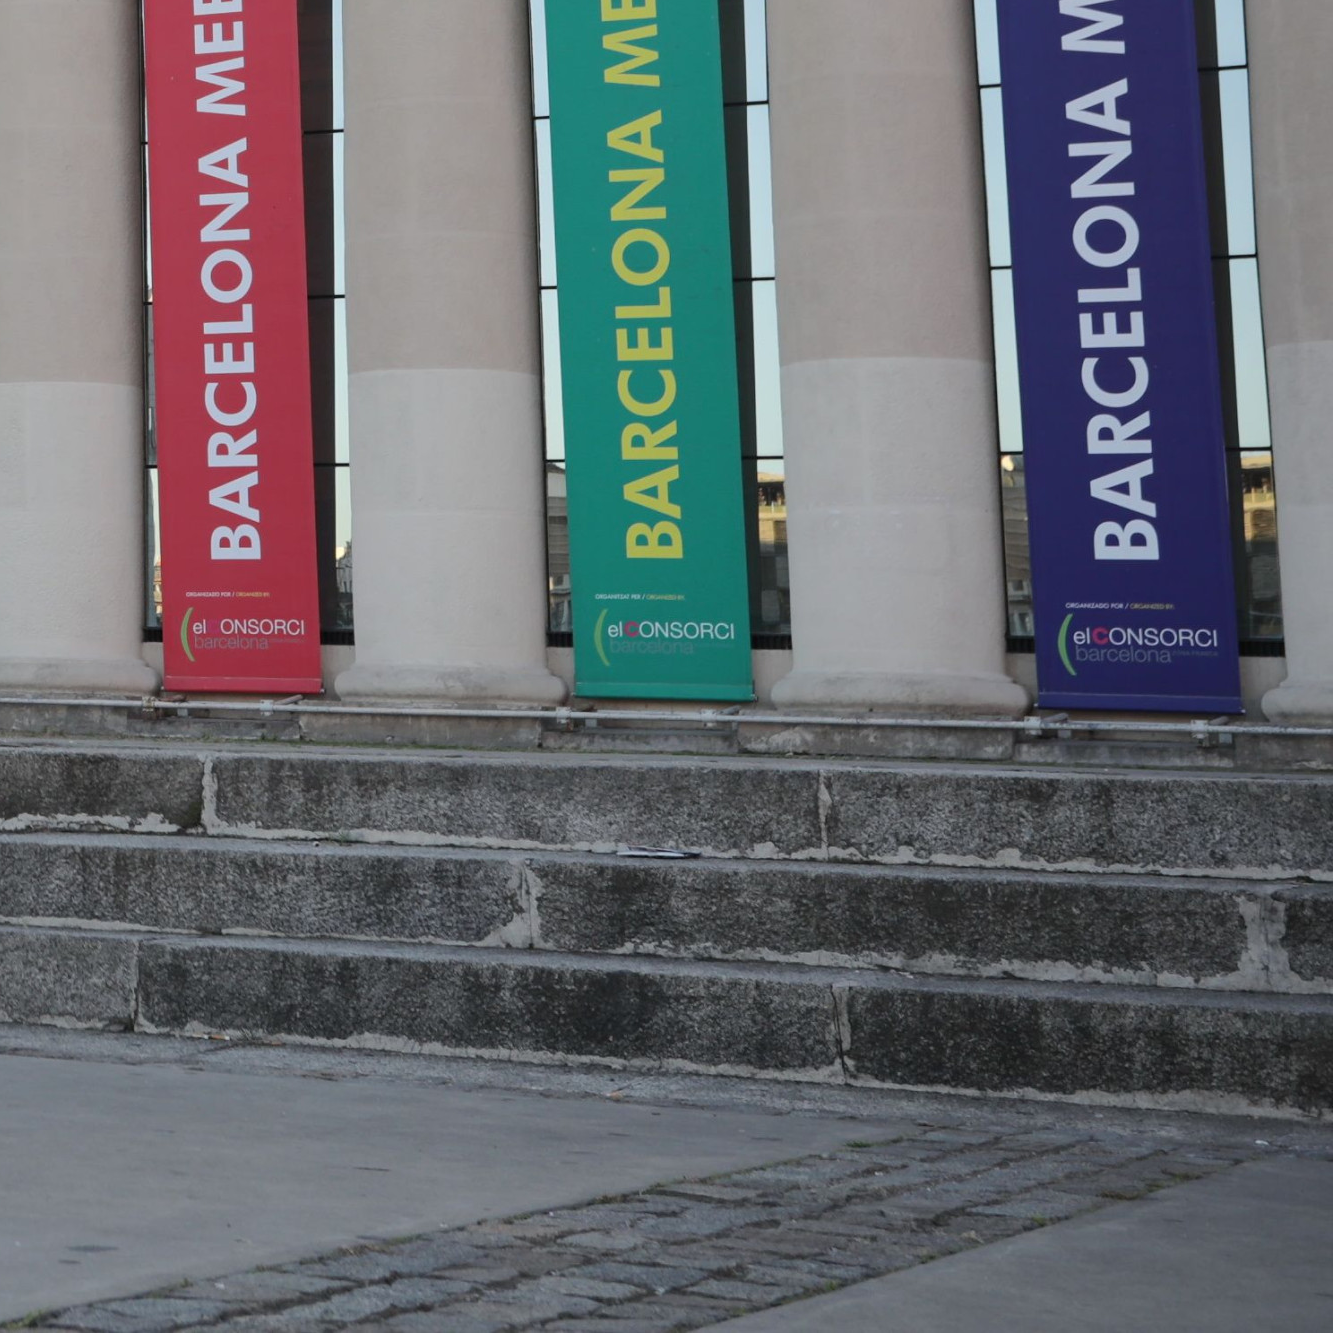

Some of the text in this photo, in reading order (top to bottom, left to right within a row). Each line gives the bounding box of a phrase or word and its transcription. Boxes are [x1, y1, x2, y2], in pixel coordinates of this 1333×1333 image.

[197, 137, 262, 561] BARCELONA
[607, 111, 683, 558] BARCELONA
[1065, 77, 1160, 561] BARCELONA
[1075, 645, 1172, 664] barcelona
